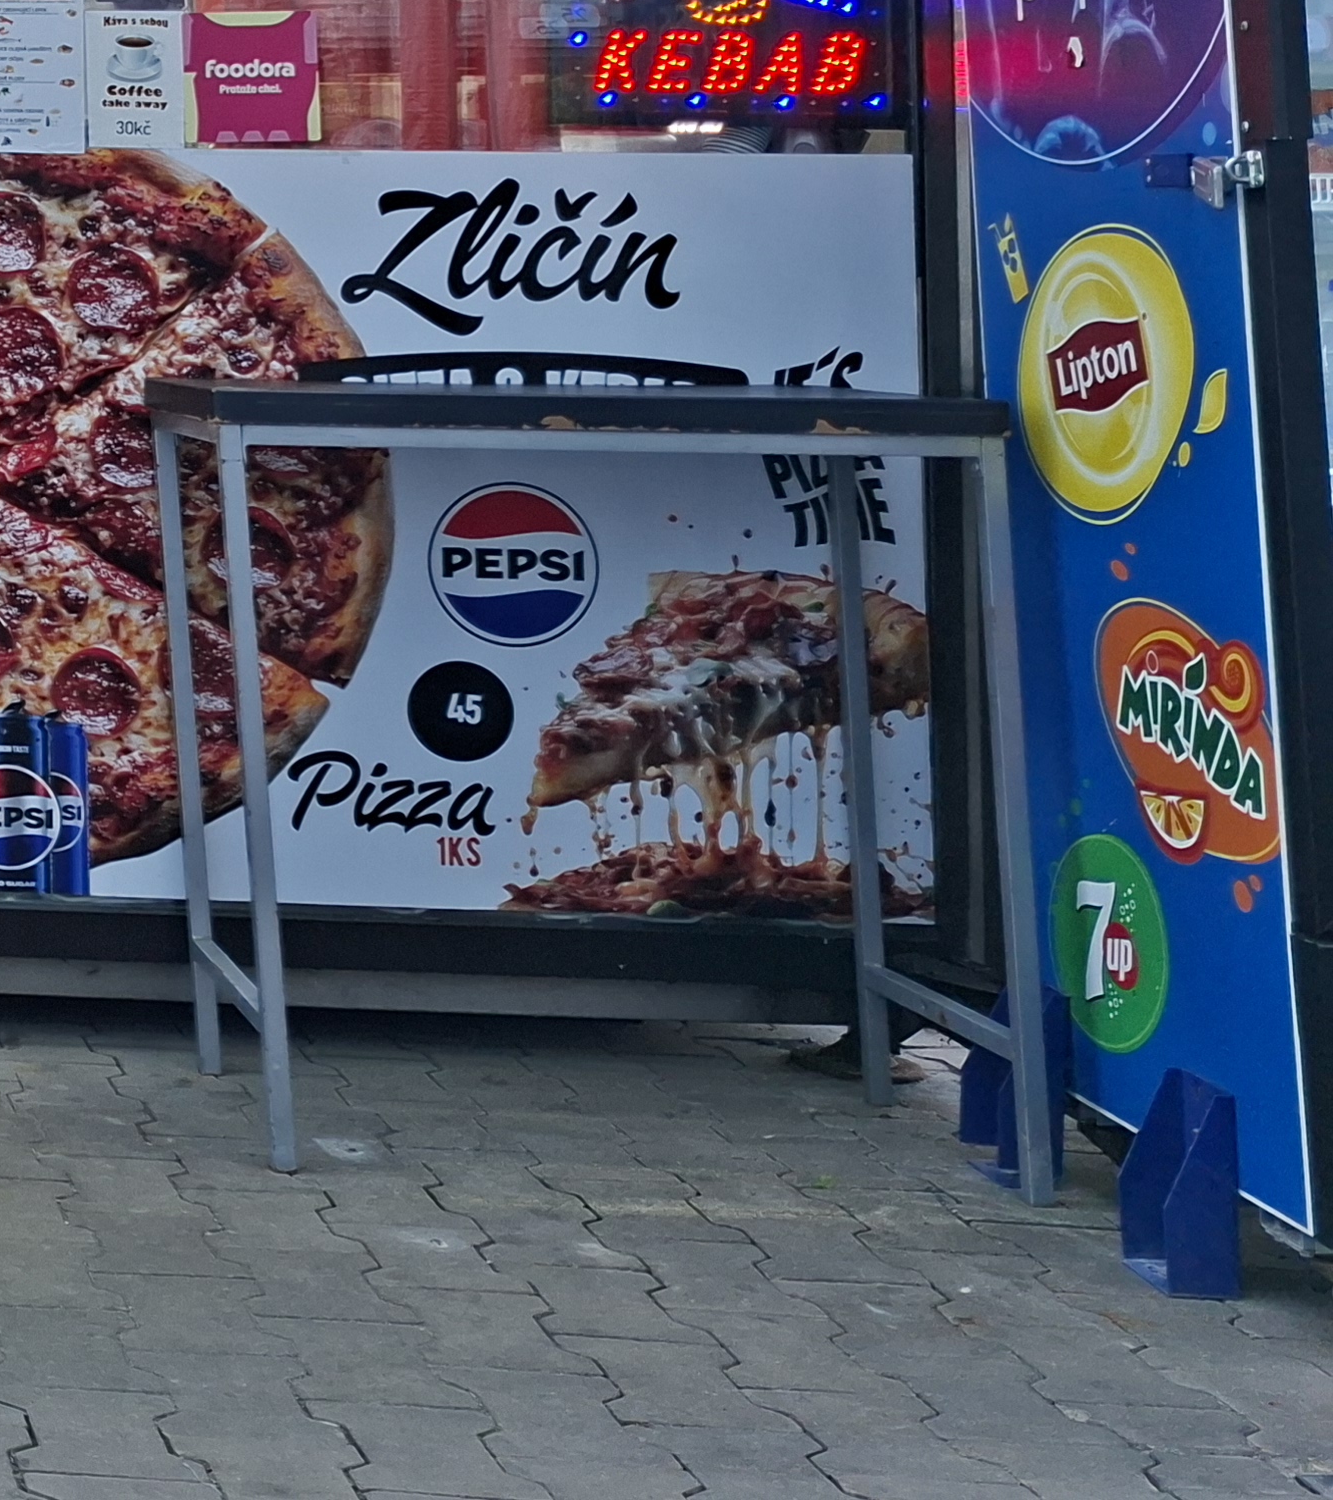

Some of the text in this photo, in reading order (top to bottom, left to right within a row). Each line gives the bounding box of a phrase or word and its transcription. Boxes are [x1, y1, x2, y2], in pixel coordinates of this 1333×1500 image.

[103, 16, 169, 28] Káva s sebou
[205, 60, 295, 79] foodora
[593, 27, 868, 95] KEBAB
[102, 99, 168, 111] take away
[107, 85, 162, 98] Coffee
[116, 120, 151, 136] 30kč
[340, 178, 681, 337] Zličín
[1055, 338, 1137, 400] Lipton
[441, 548, 584, 583] PEPSI
[447, 694, 483, 723] 45
[287, 751, 497, 833] Pizza
